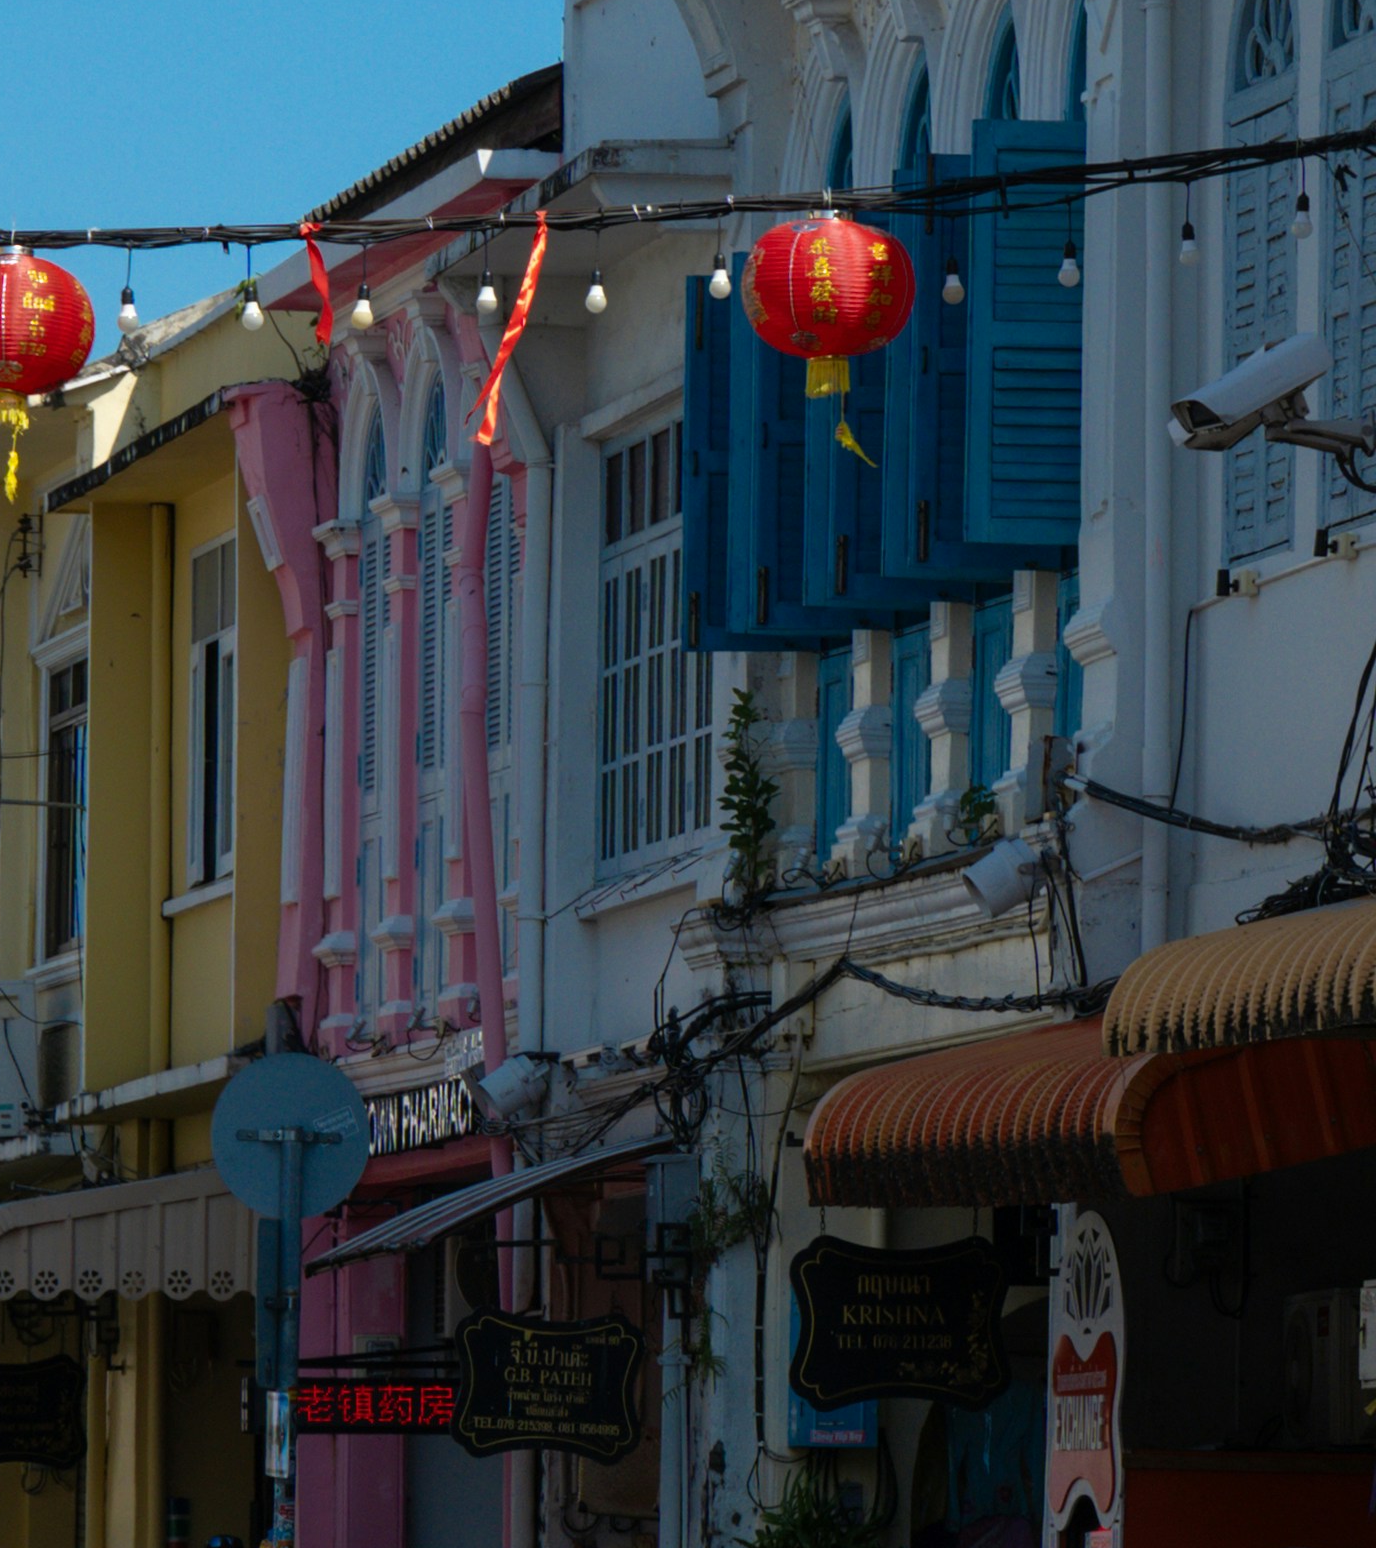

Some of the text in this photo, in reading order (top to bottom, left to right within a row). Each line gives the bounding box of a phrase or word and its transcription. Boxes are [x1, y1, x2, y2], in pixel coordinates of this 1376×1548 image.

[365, 1096, 397, 1156] OWN
[842, 1304, 945, 1325] KRISHNA
[504, 1367, 592, 1386] G.B. PATEH
[297, 1385, 455, 1425] 老镇药房
[1055, 1395, 1105, 1451] EXCHANGE
